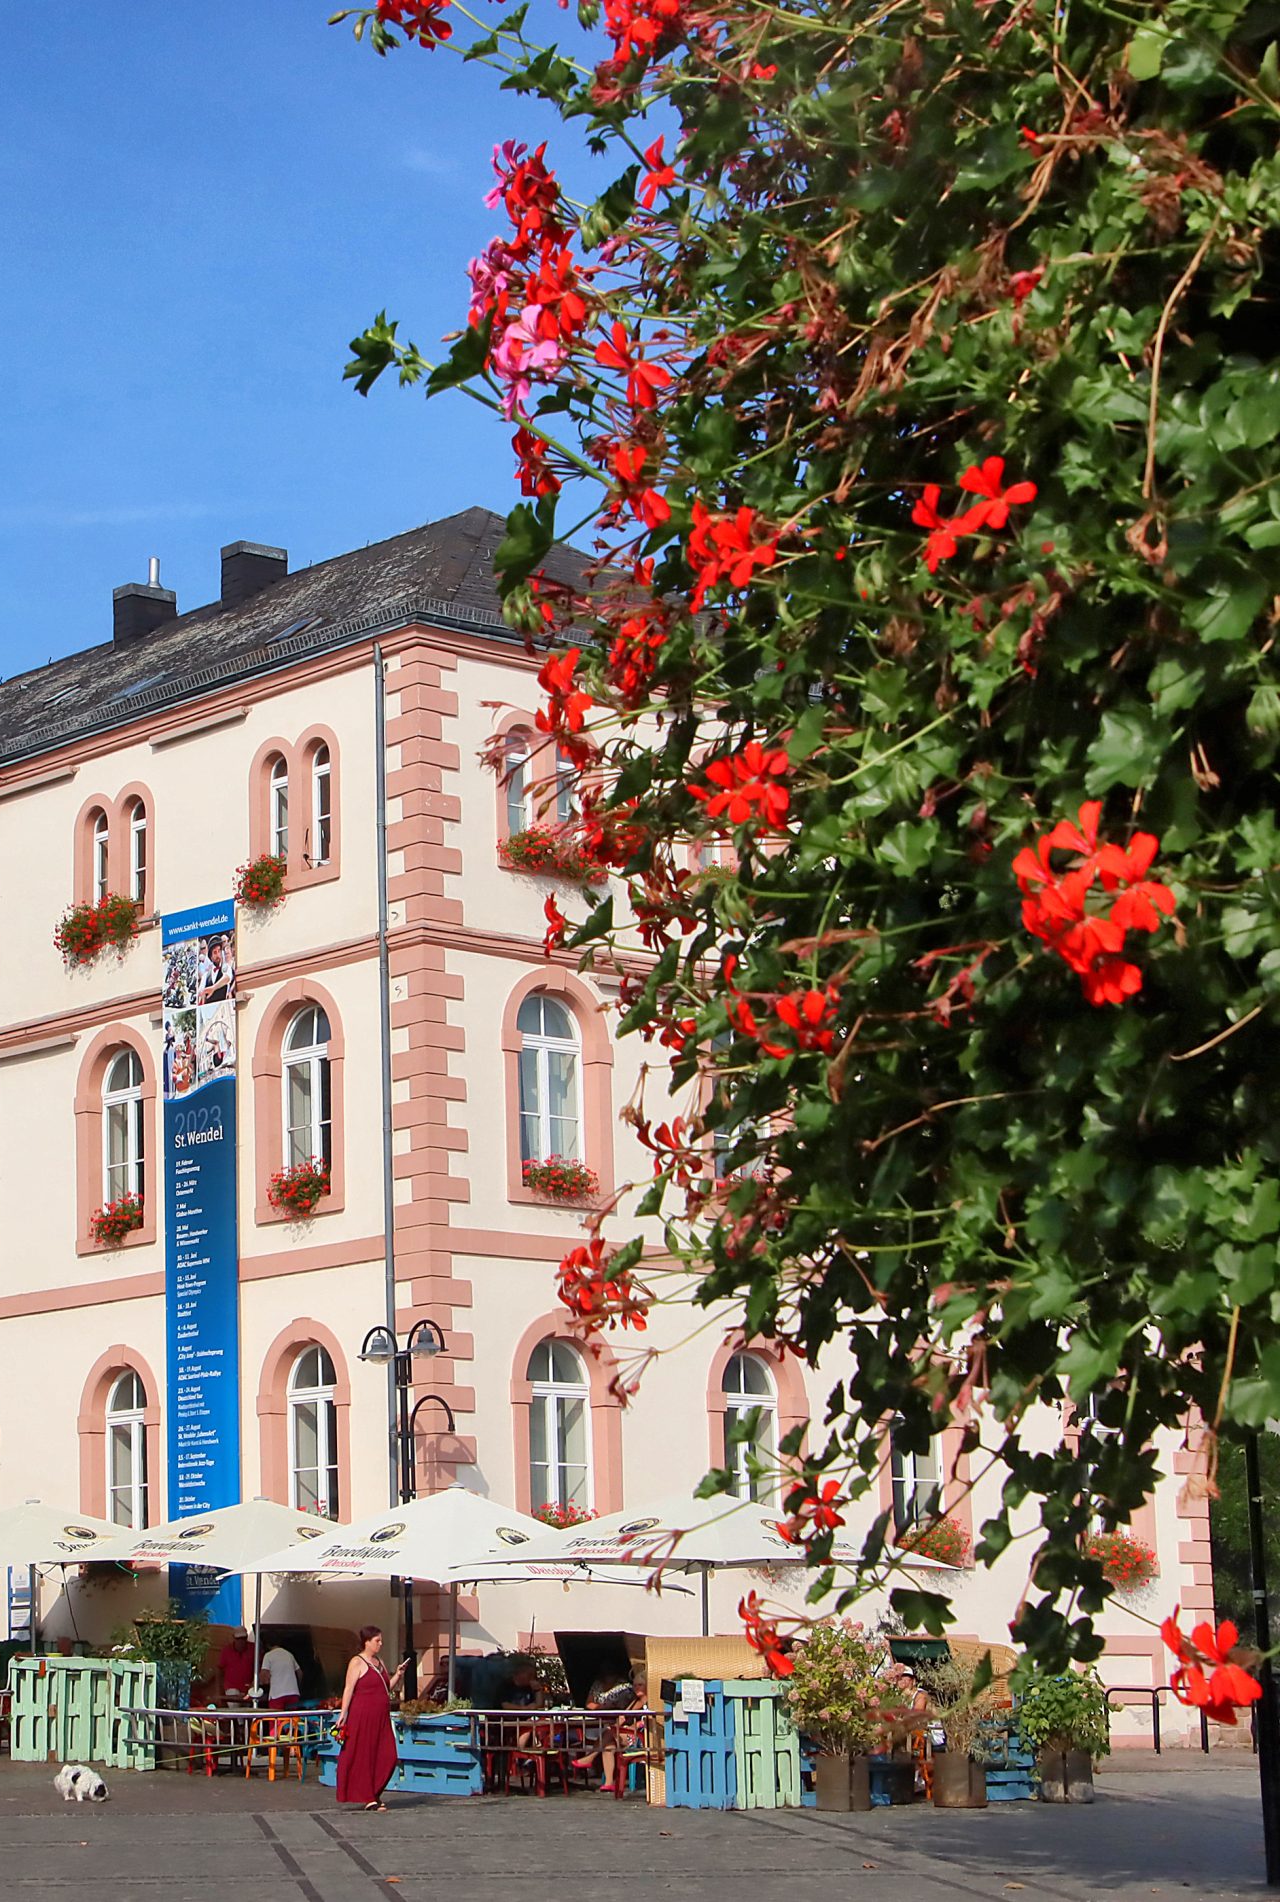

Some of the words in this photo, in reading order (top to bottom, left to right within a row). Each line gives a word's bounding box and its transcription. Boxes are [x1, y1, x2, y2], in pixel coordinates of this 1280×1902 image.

[168, 914, 228, 935] www.sankt-wendel.de
[175, 1105, 222, 1134] 2023
[174, 1134, 187, 1149] St.
[187, 1125, 223, 1146] Wendel
[318, 1545, 401, 1559] Benediktiner
